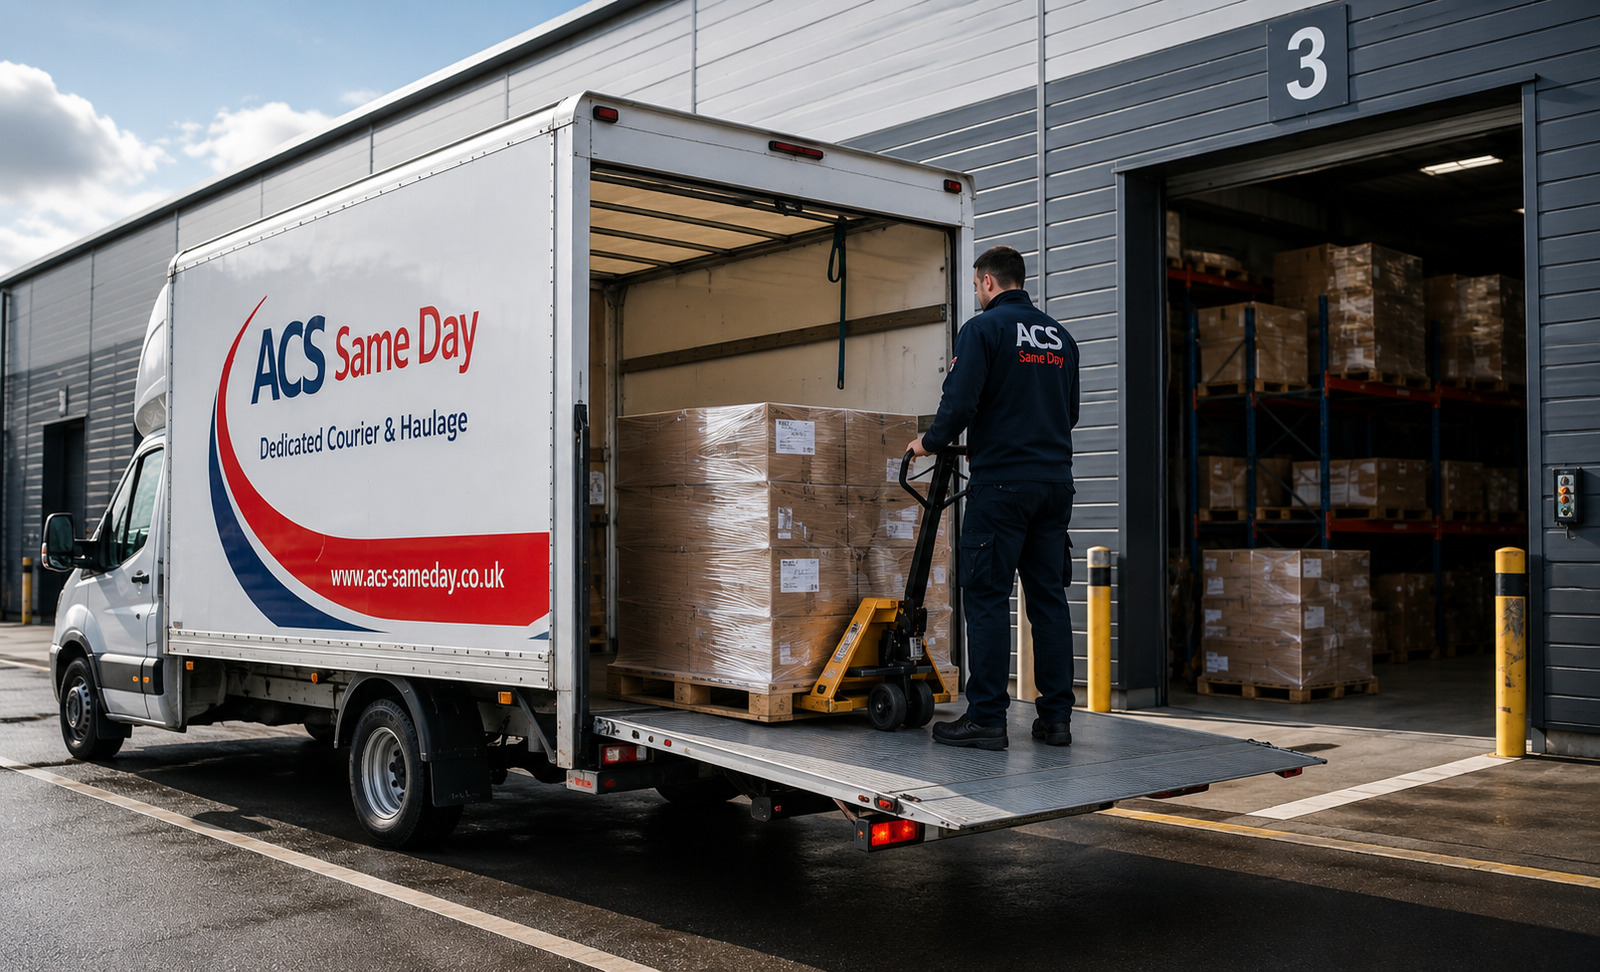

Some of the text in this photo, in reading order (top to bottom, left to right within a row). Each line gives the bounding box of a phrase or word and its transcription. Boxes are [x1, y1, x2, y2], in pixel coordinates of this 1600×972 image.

[1286, 26, 1328, 101] 3
[250, 305, 480, 405] ACS Same Day
[1015, 322, 1063, 351] ACS
[1018, 350, 1064, 369] Same Day
[261, 409, 467, 459] Dedicated Courier & Haulage
[330, 560, 505, 595] www.acs-sameday.co.uk
